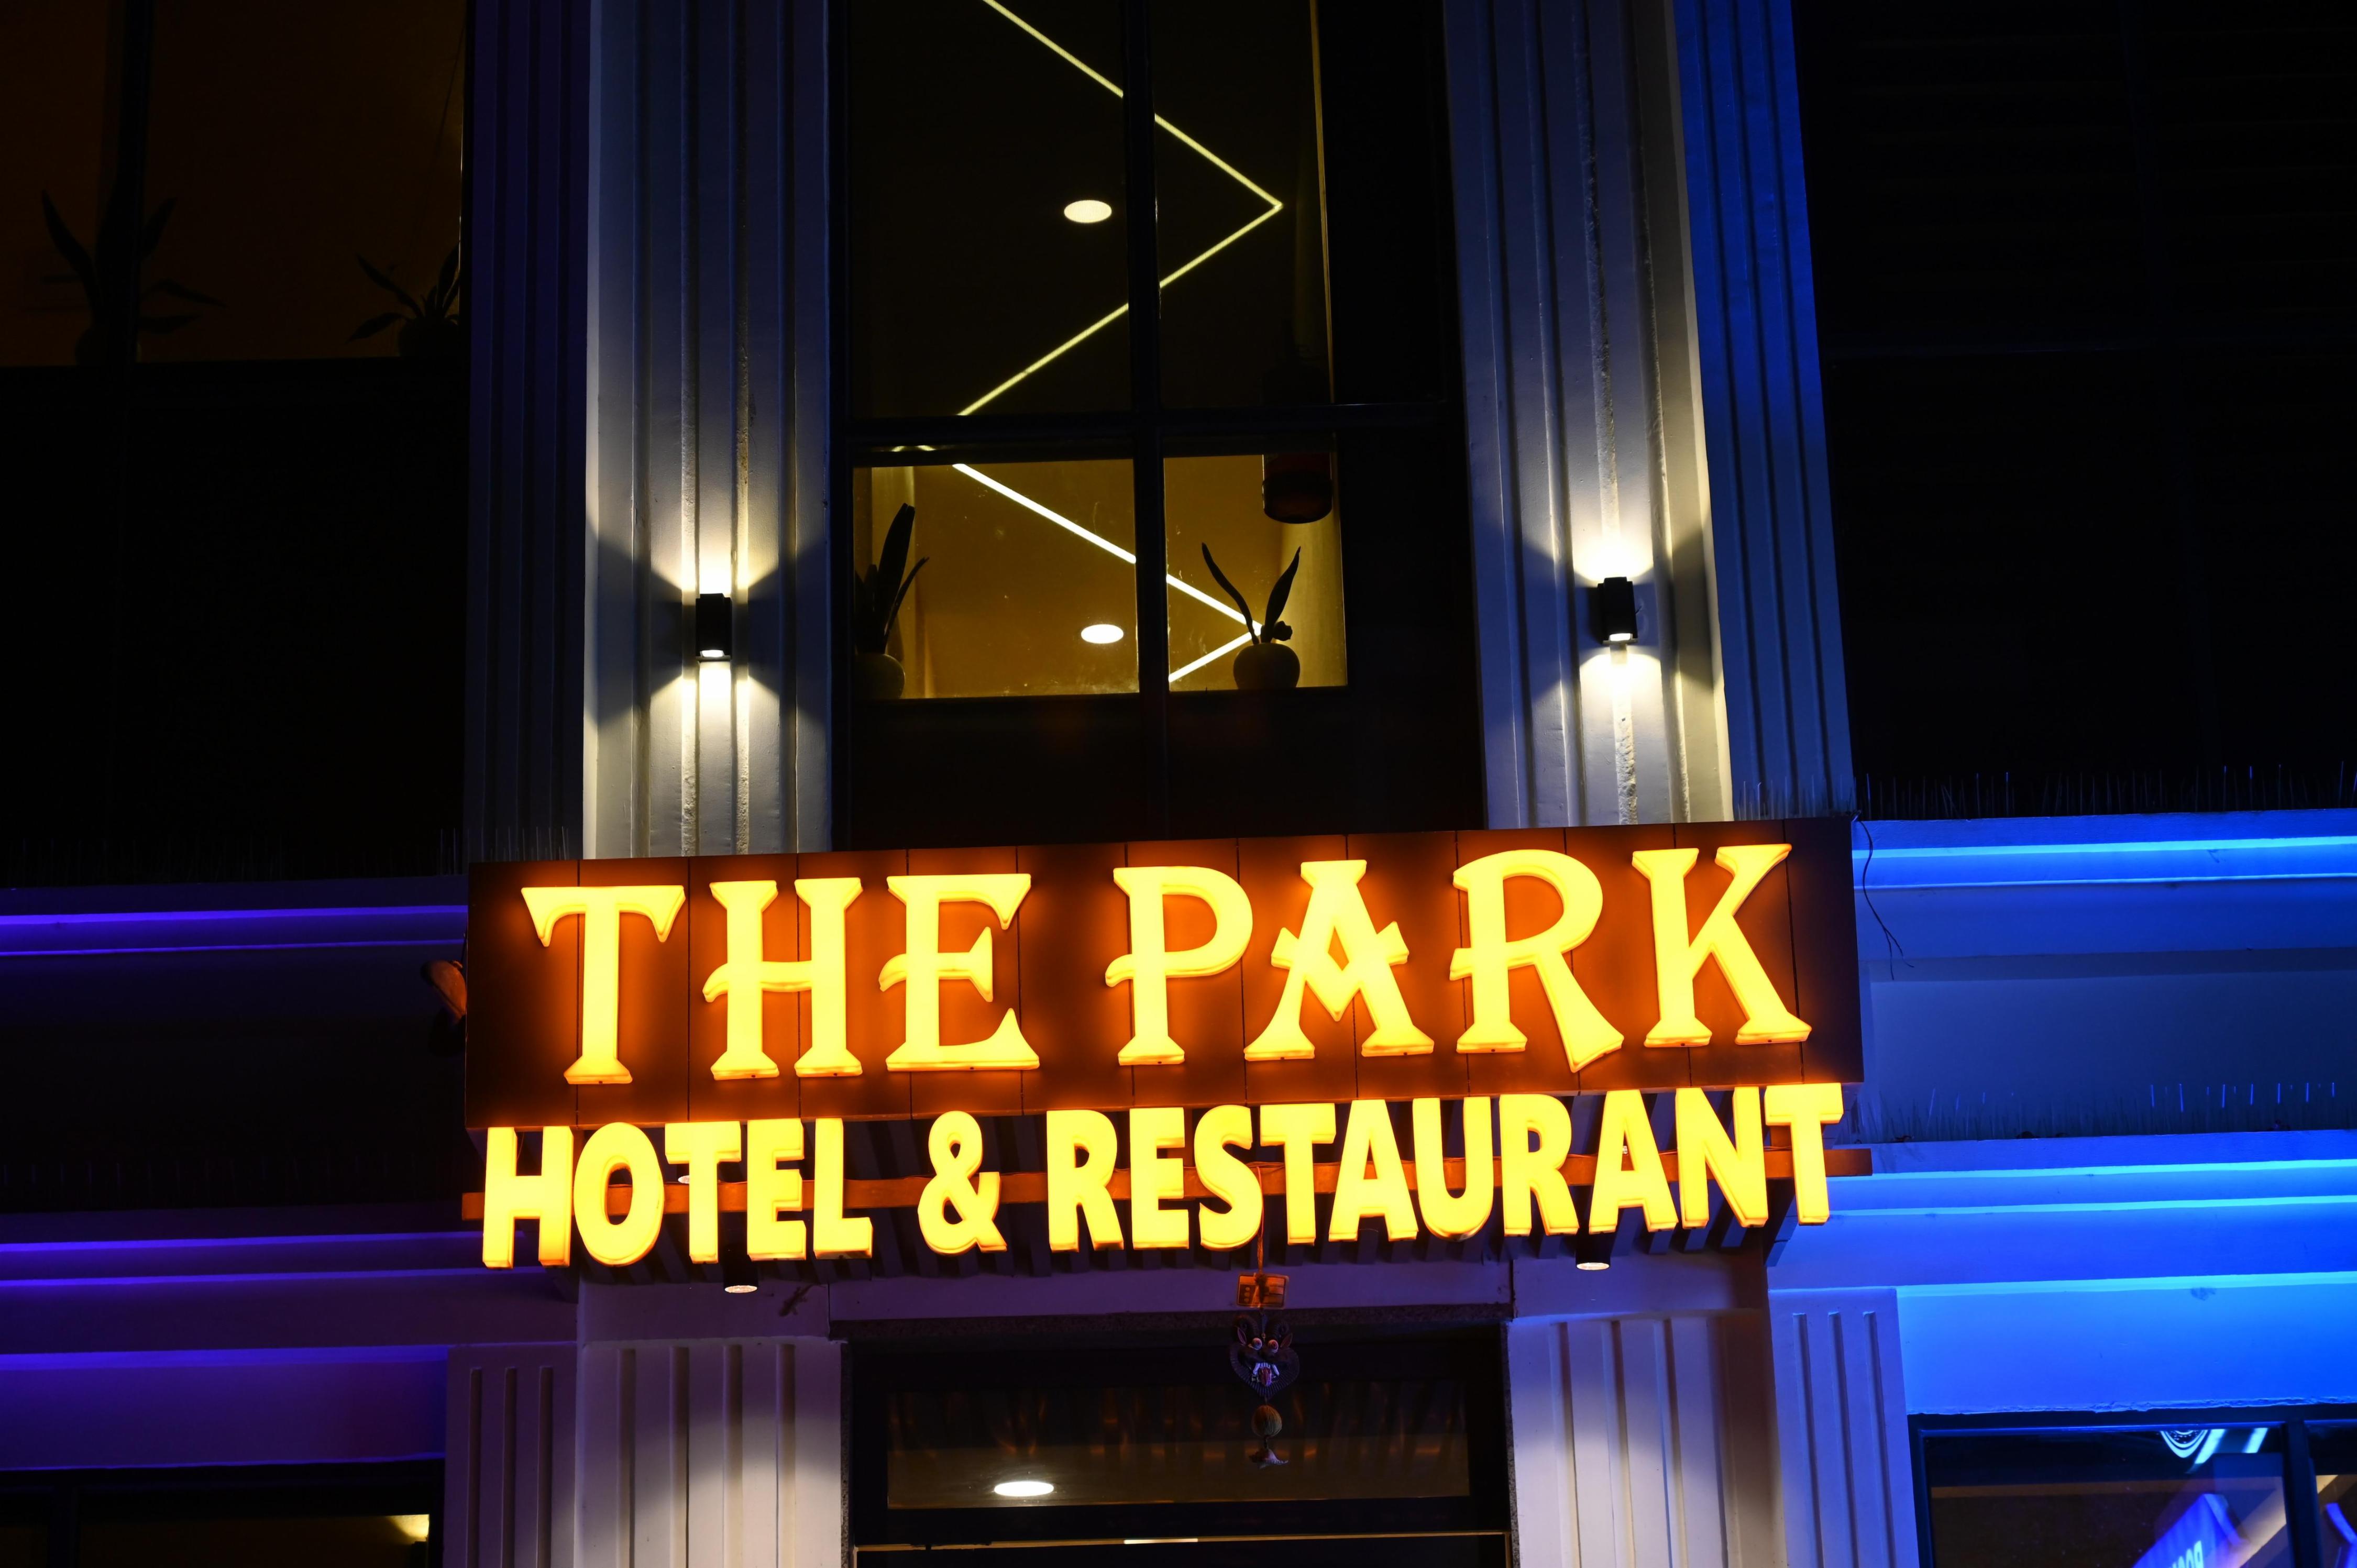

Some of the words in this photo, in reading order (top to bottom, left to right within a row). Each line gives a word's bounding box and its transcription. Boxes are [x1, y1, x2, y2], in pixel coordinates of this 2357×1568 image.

[521, 873, 1040, 1085] THE
[1105, 843, 1812, 1073] PARK
[482, 1117, 874, 1268] HOTEL
[918, 1110, 1007, 1255] &
[1046, 1082, 1844, 1252] RESTAURANT
